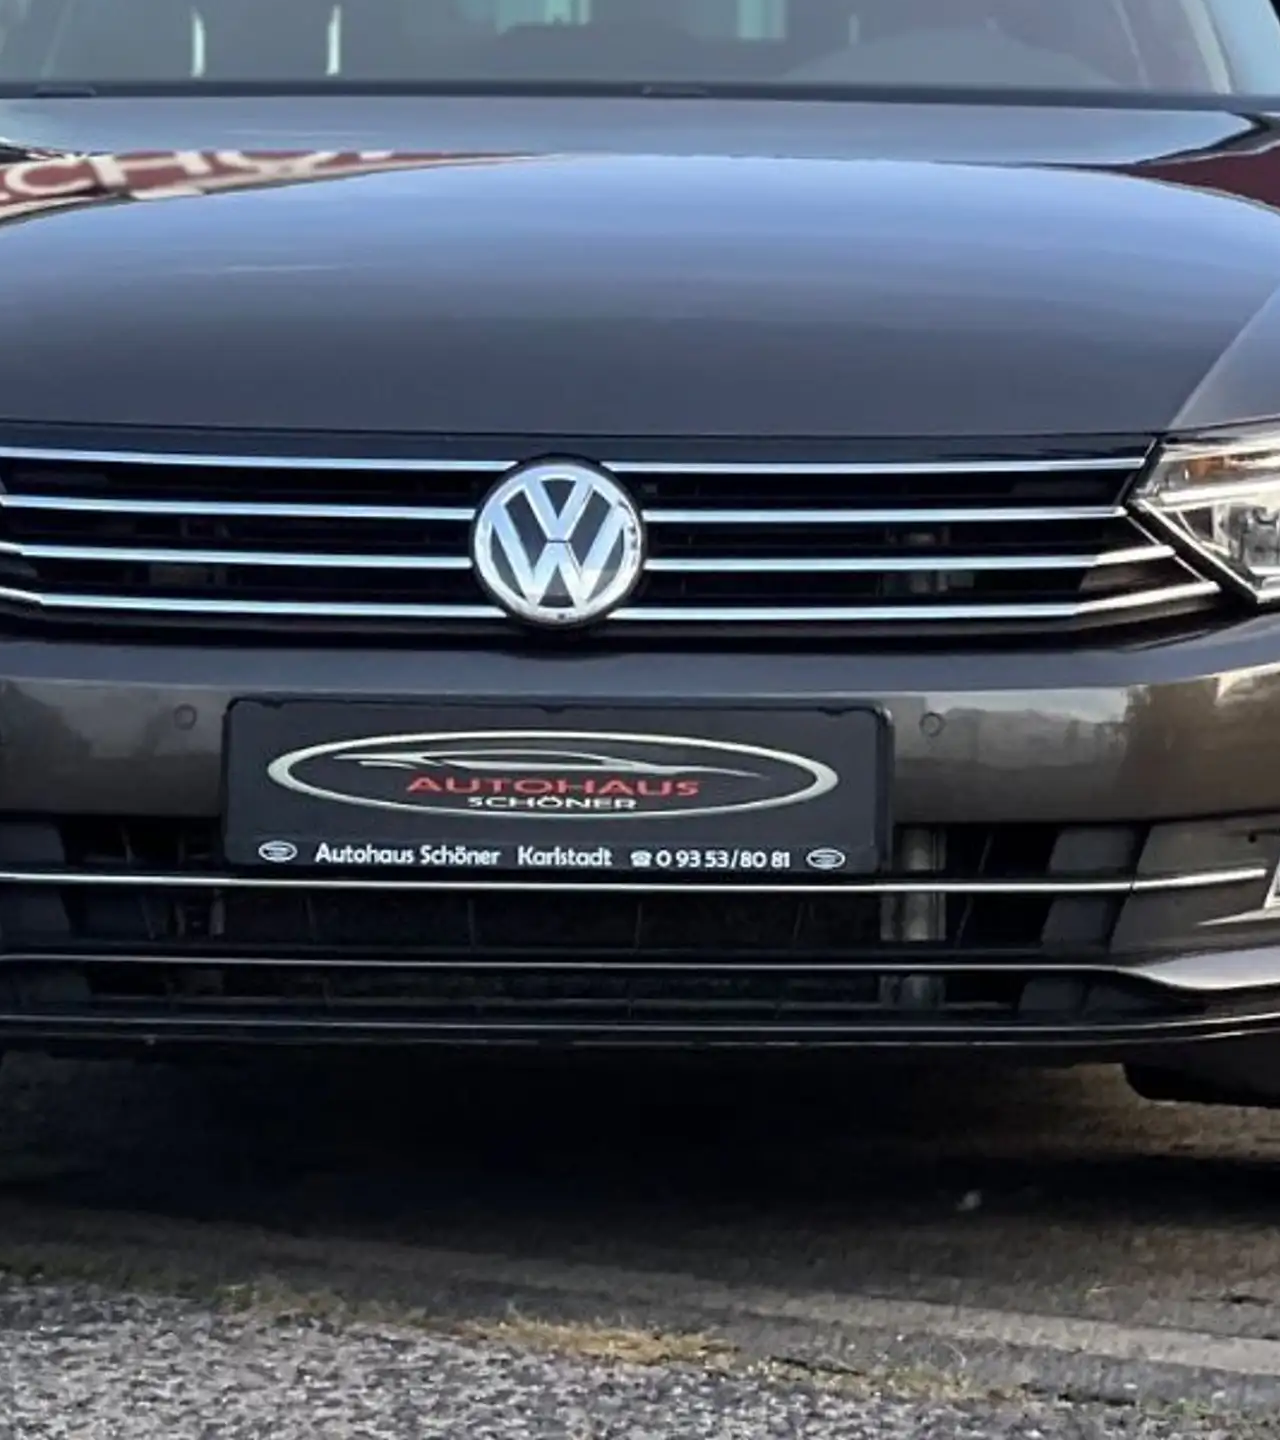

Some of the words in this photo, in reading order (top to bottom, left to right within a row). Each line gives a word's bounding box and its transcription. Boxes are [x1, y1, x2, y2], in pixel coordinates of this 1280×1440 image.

[476, 466, 641, 622] VW
[407, 776, 699, 795] AUTOHAUS
[468, 795, 636, 809] SCHÖNER
[315, 843, 414, 864] Autohaus
[420, 844, 501, 865] Schöner
[518, 845, 612, 867] Karlstadt
